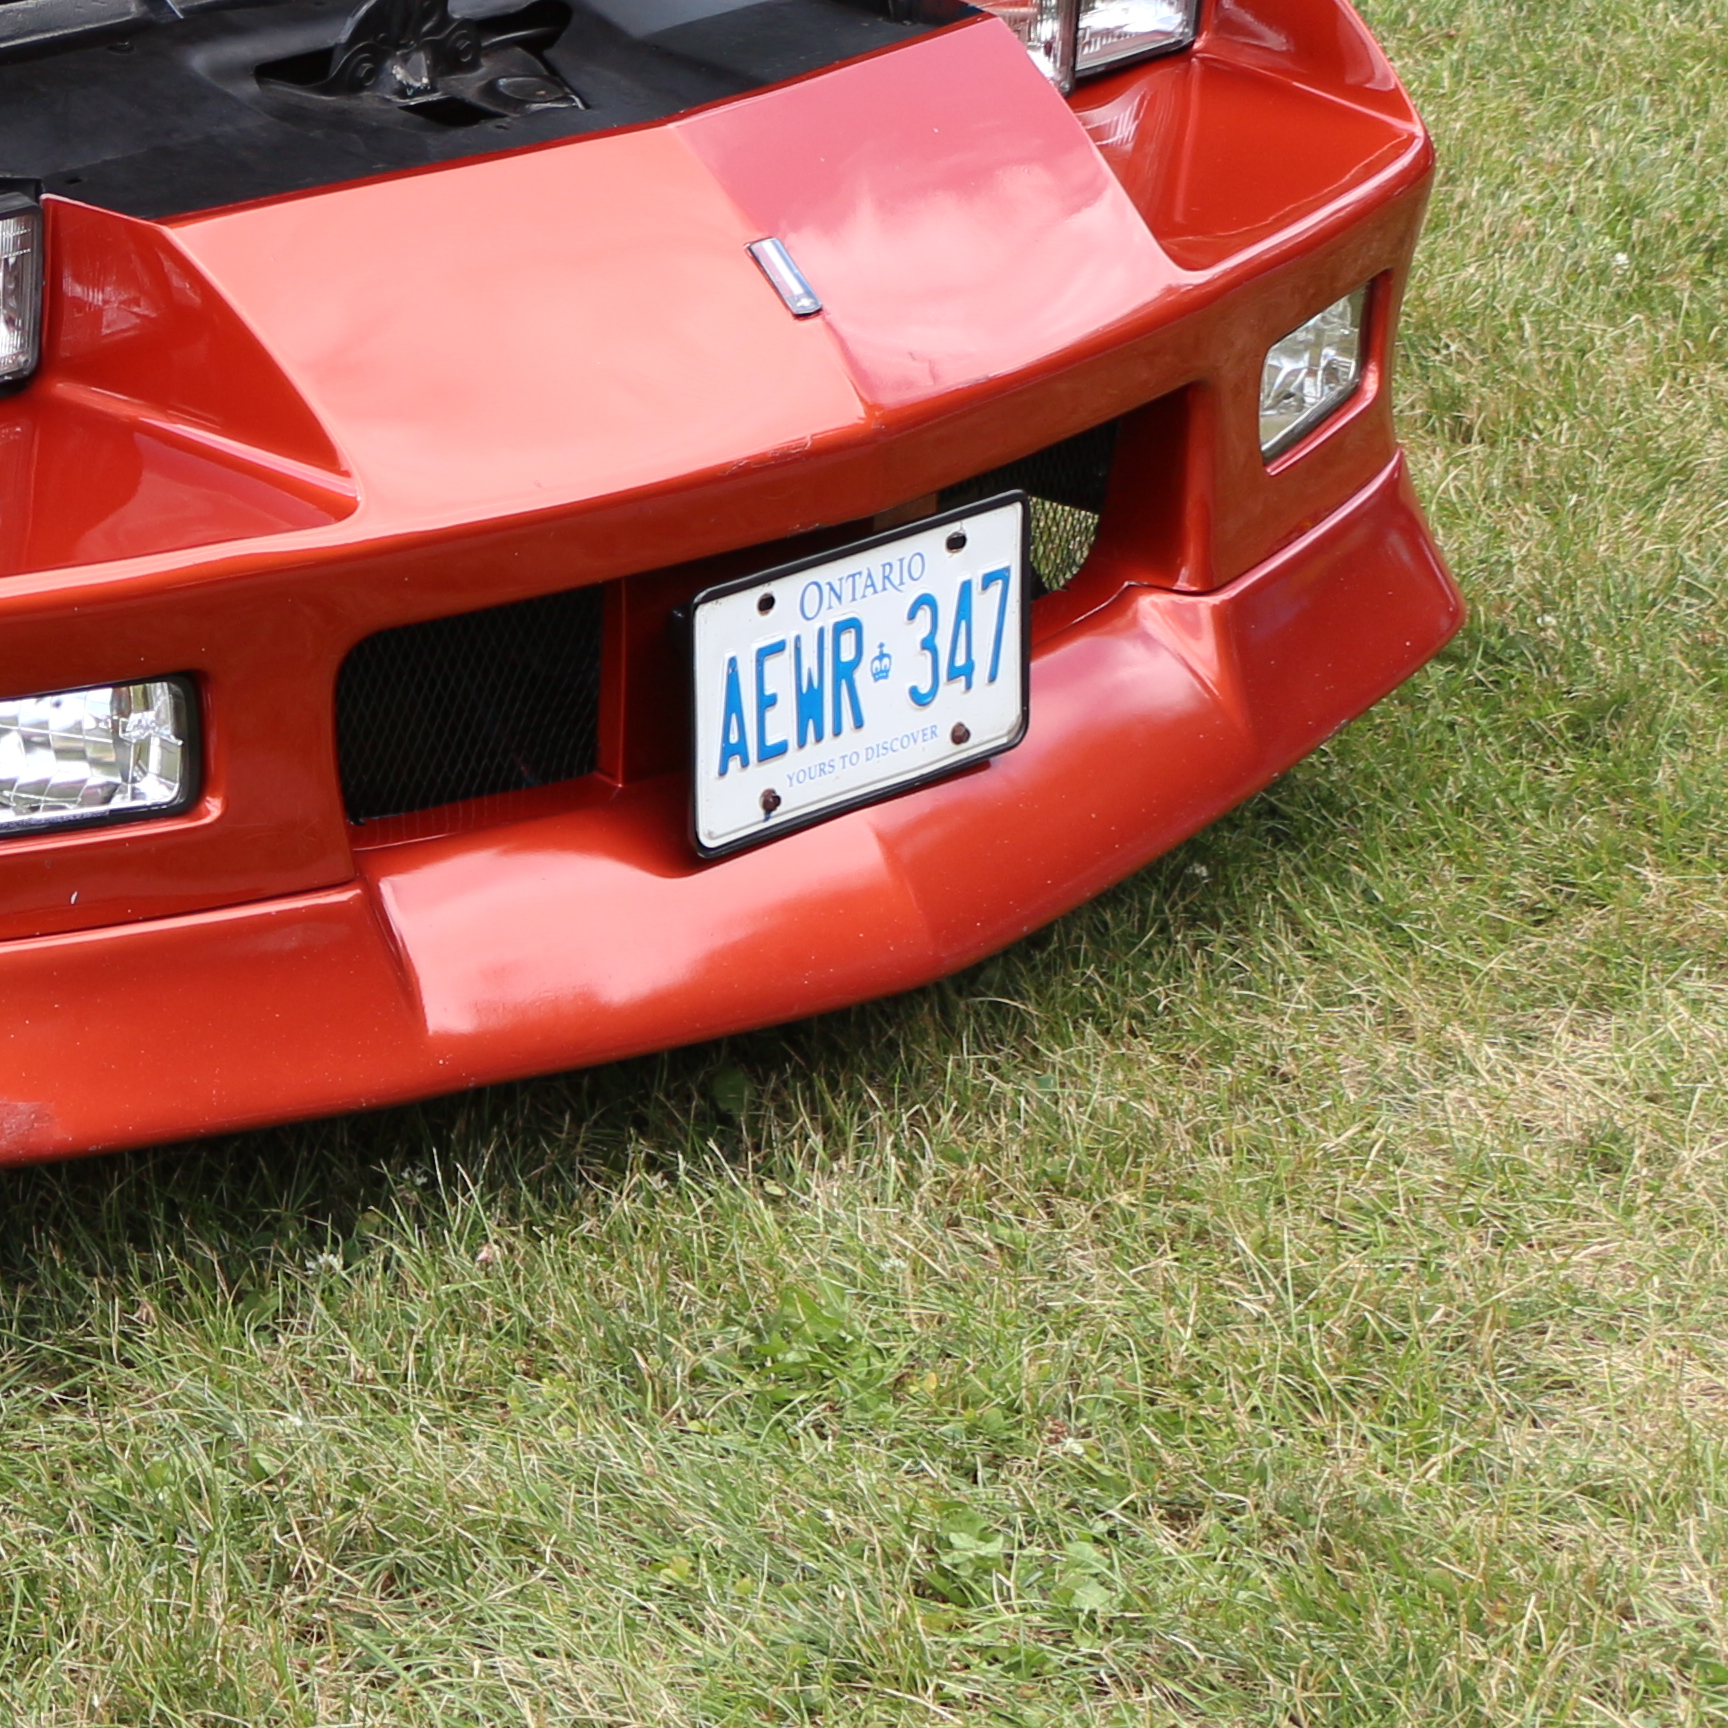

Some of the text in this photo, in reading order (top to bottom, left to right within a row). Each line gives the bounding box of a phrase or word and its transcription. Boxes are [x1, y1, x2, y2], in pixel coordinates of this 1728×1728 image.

[799, 551, 926, 621] ONTARIO
[717, 565, 1012, 777] AEWR 347
[786, 724, 939, 788] YOURS TO DISCOVER
